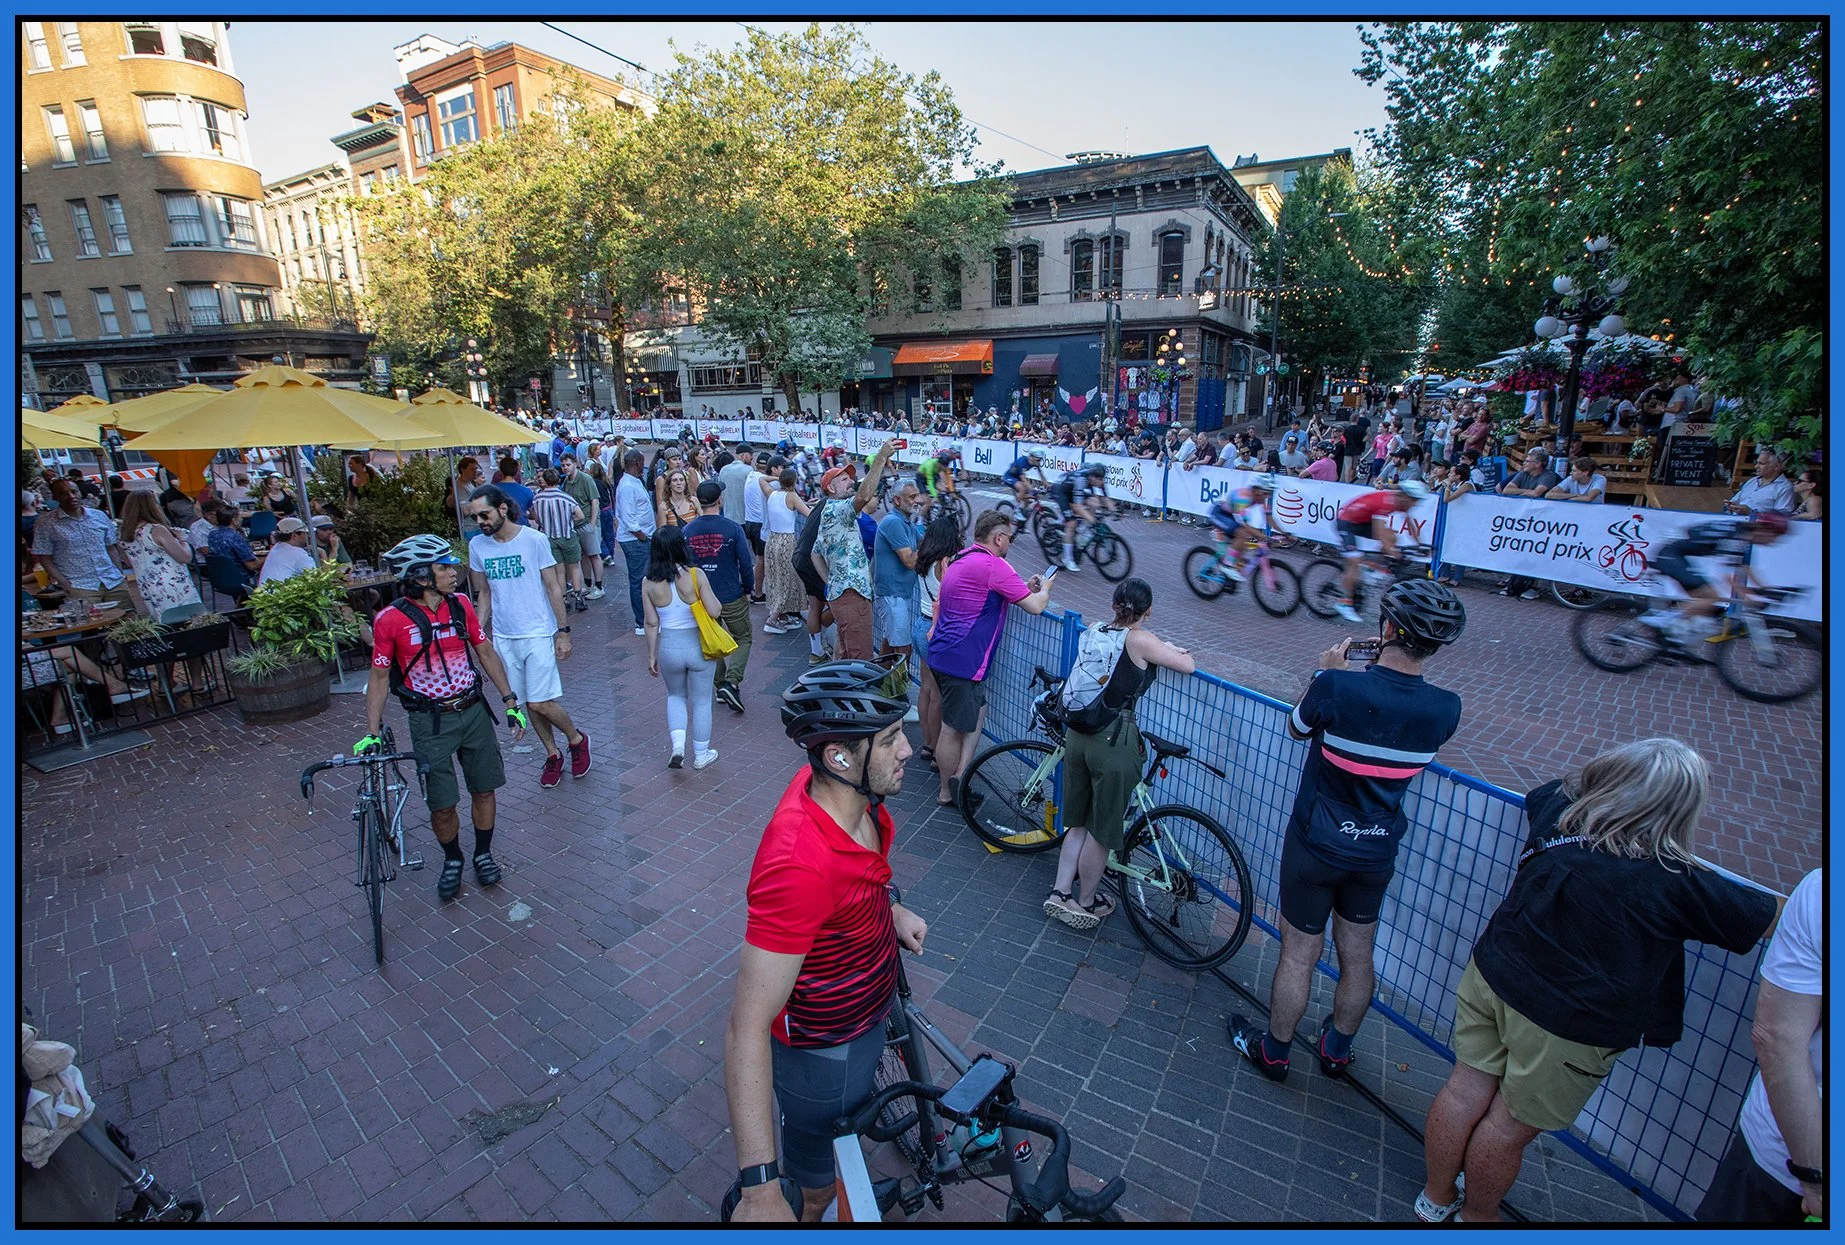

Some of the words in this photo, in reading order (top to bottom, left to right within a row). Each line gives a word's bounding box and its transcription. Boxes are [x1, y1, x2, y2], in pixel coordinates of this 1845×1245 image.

[975, 447, 992, 465] Bell
[1671, 460, 1705, 469] PRIVATE
[1675, 470, 1702, 478] EVENT
[1115, 478, 1128, 489] prix
[1201, 478, 1228, 503] Bell
[1491, 515, 1579, 537] gastown
[1489, 535, 1550, 555] grand
[1552, 541, 1594, 561] prix
[484, 555, 522, 569] BETTER
[512, 566, 525, 577] UP
